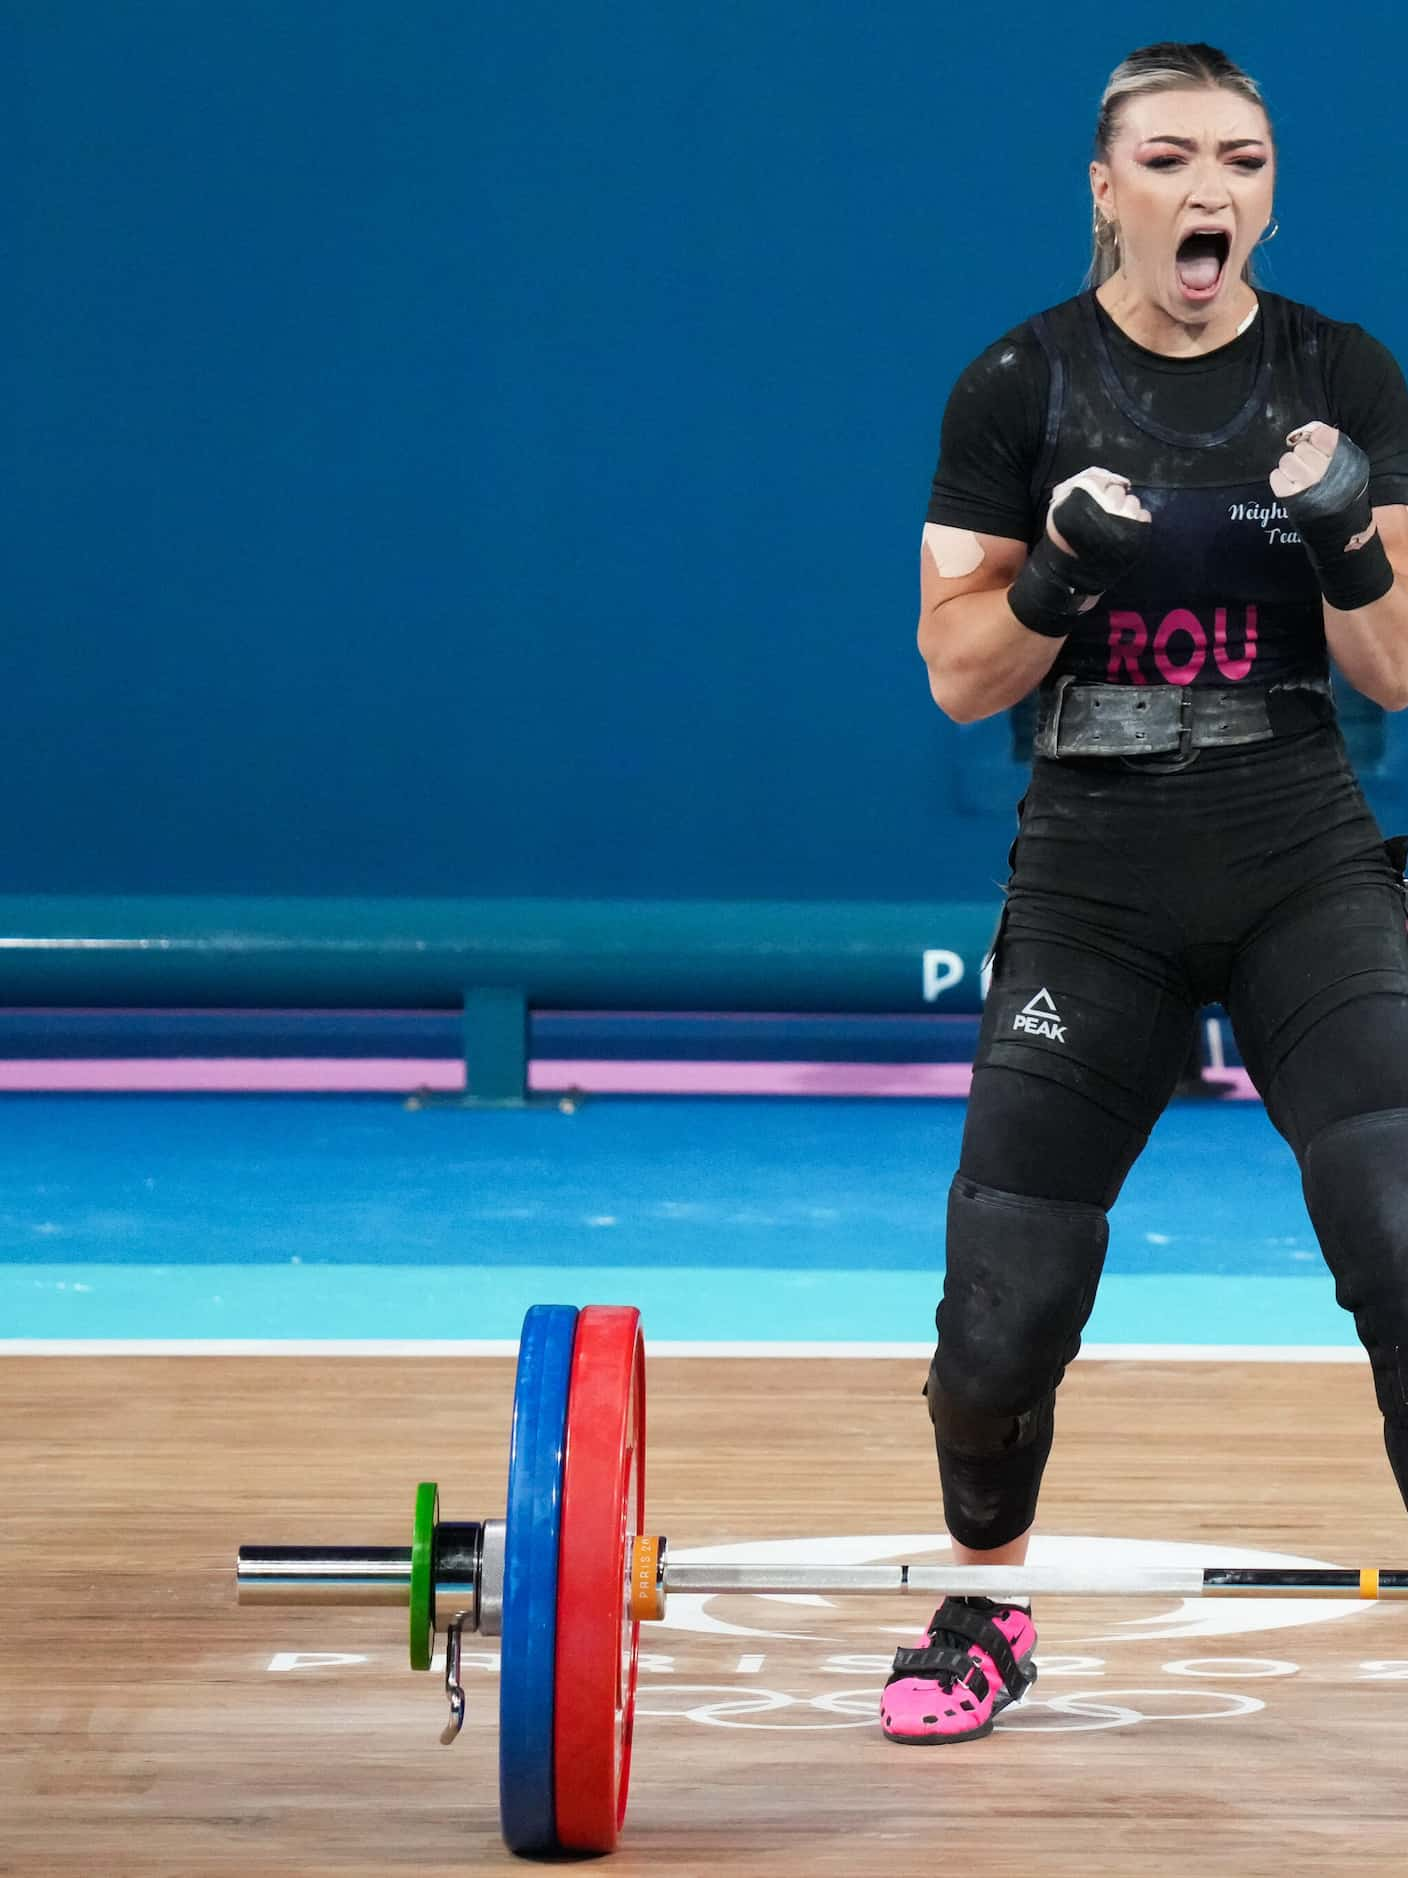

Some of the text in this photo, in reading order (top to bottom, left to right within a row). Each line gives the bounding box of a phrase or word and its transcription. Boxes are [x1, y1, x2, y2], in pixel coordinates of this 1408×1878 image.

[1264, 528, 1302, 544] Tea
[1107, 605, 1258, 686] ROU
[1012, 1014, 1068, 1043] PEAK
[640, 1556, 650, 1598] PARIS
